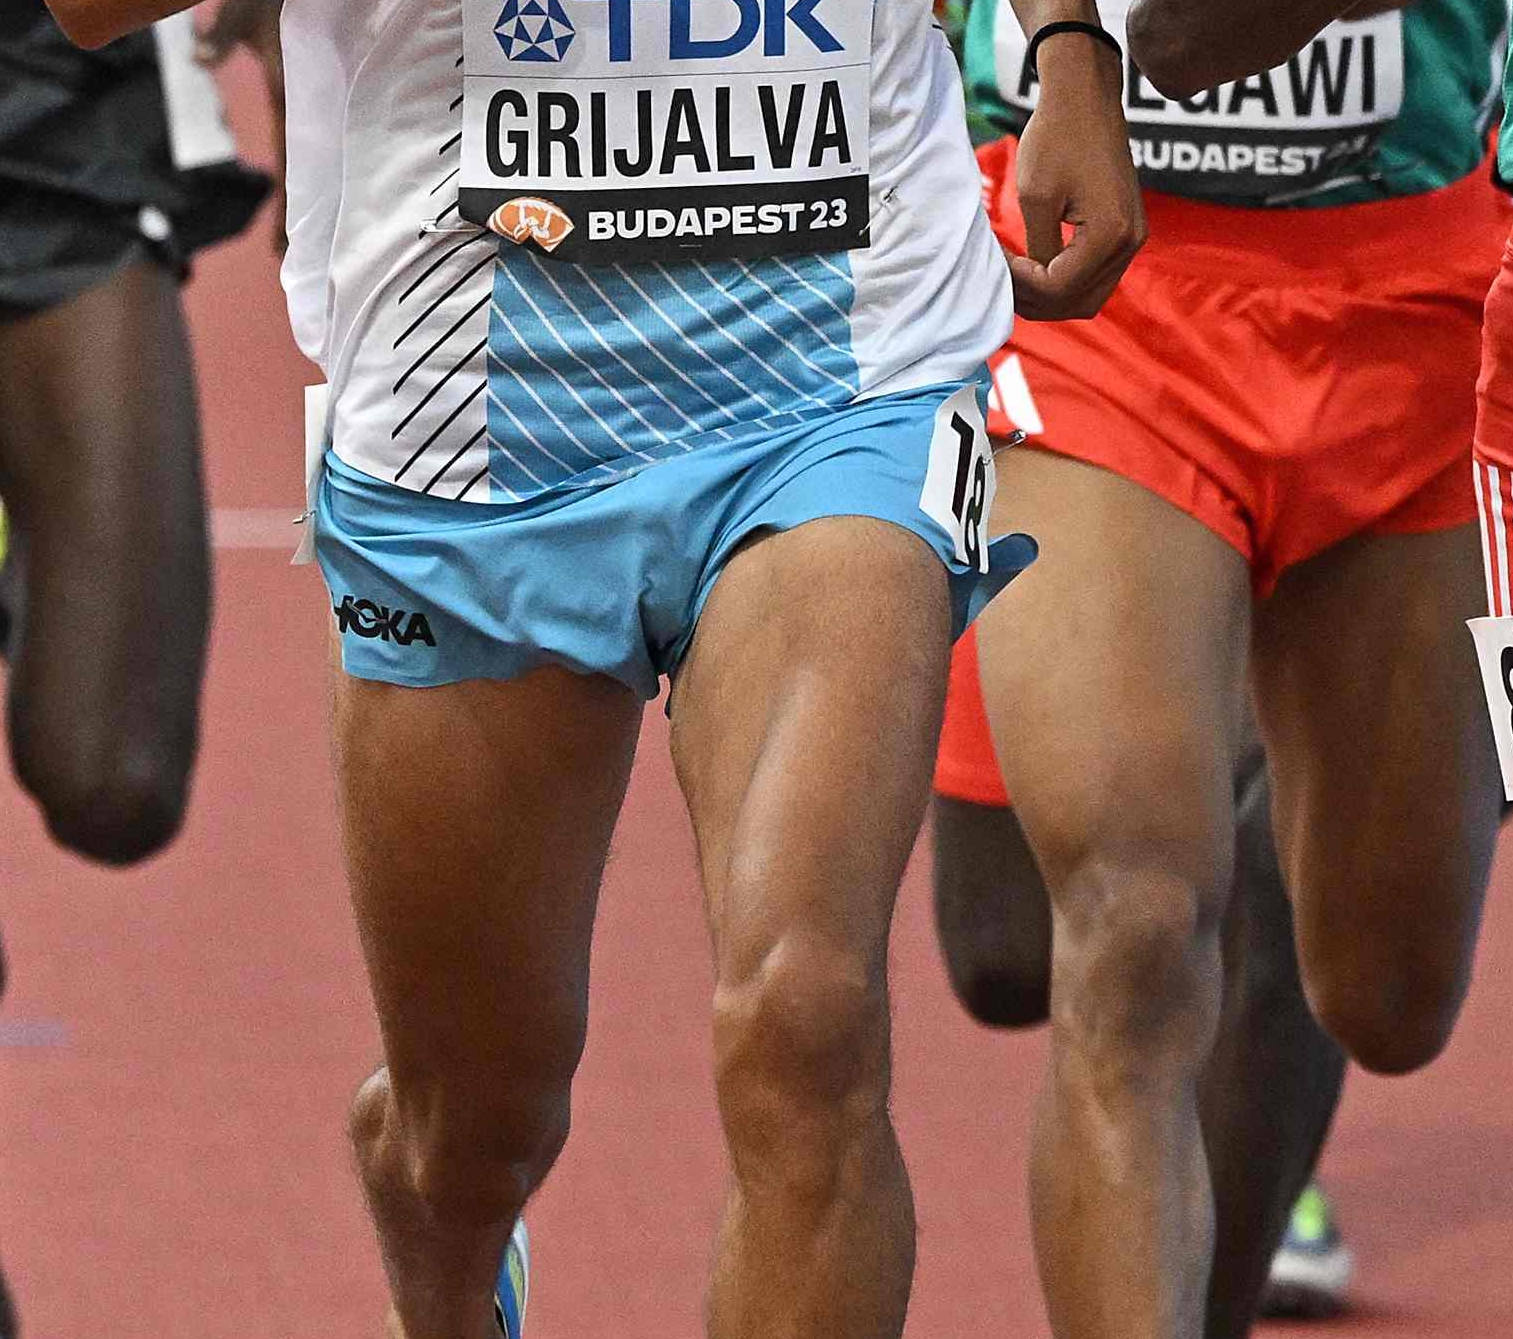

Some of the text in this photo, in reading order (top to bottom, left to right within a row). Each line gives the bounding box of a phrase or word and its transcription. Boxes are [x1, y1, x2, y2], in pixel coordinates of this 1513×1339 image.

[486, 80, 852, 178] GRIJALVA
[588, 199, 848, 241] BUDAPEST 23
